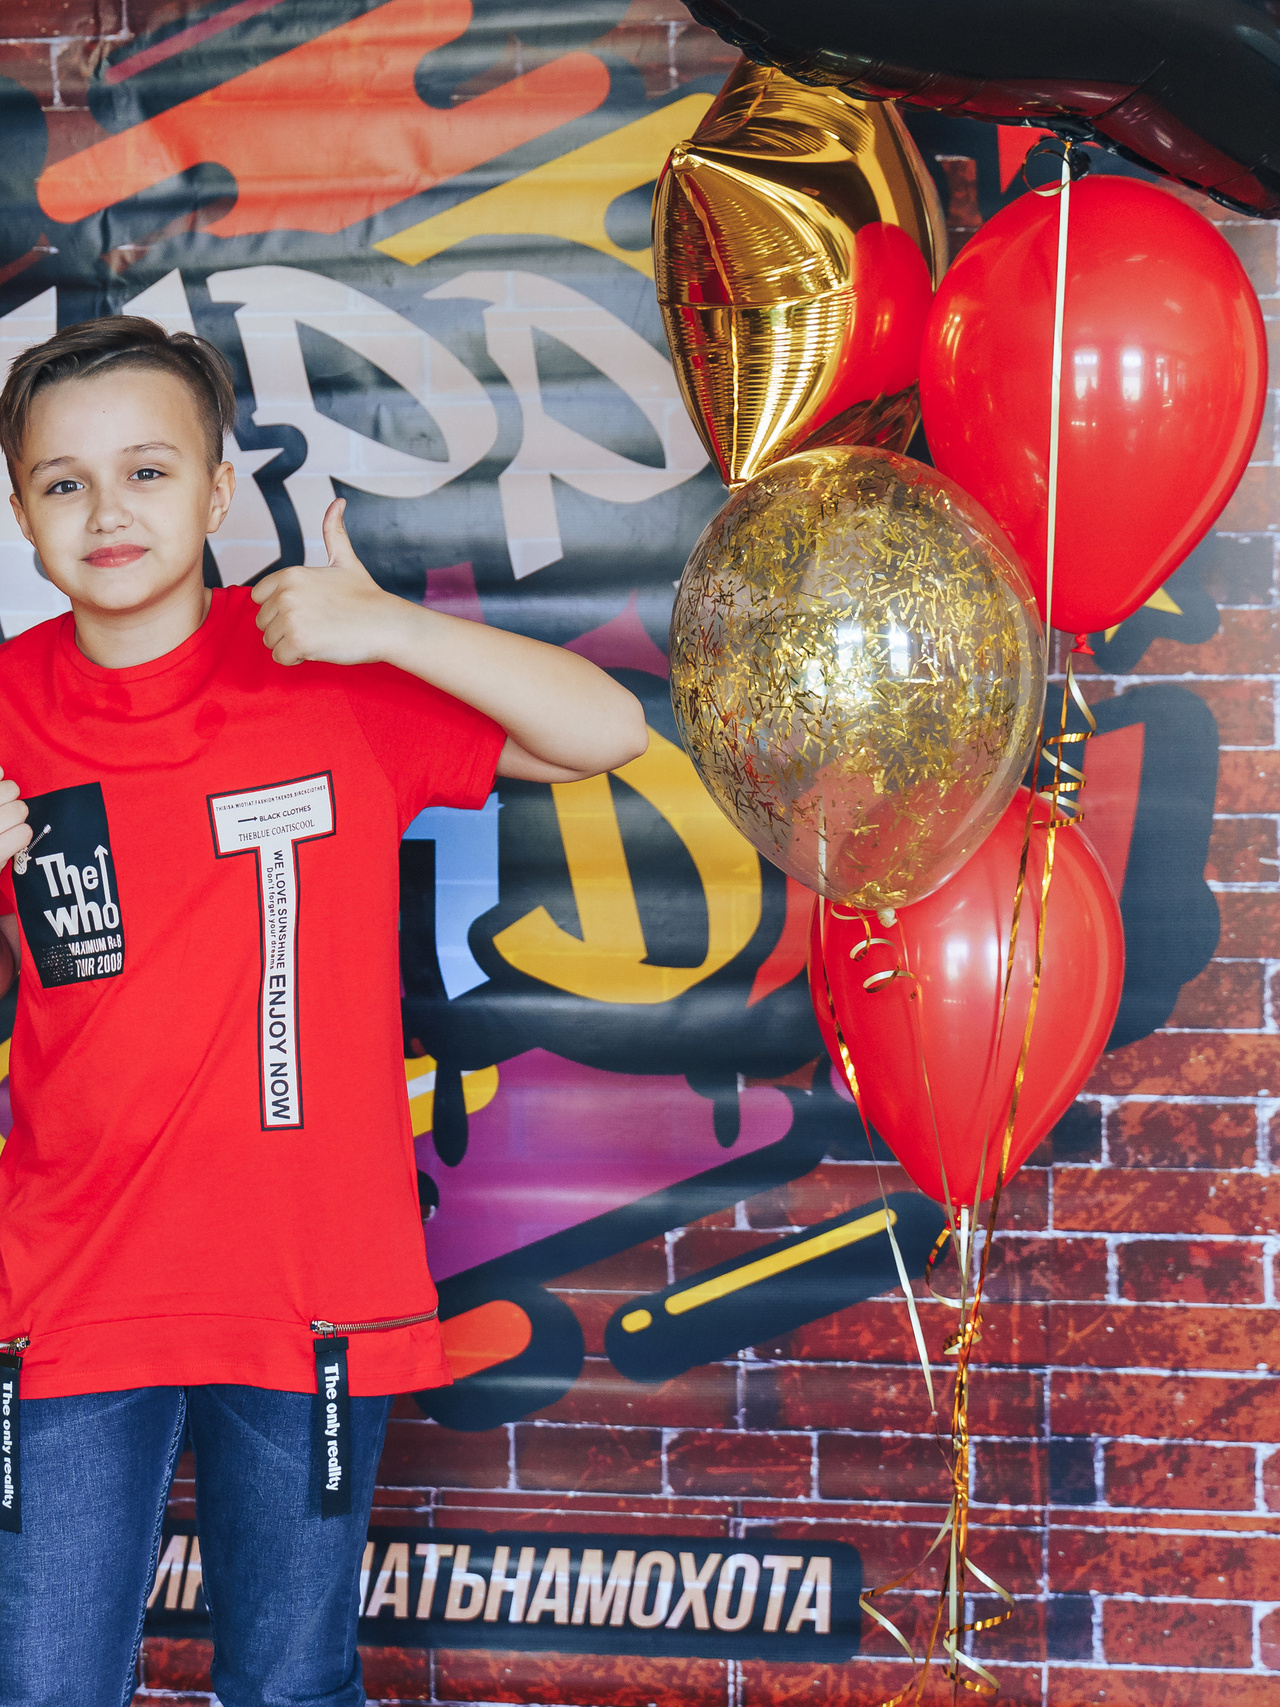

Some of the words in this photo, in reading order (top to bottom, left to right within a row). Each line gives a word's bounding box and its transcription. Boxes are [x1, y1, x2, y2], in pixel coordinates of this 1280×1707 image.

[259, 812, 281, 823] BLACK
[282, 804, 312, 818] CLOTHES
[35, 852, 99, 898] The
[273, 849, 284, 869] WE
[266, 867, 275, 890] Don't
[275, 872, 287, 905] LOVE
[267, 891, 276, 917] forget
[268, 918, 277, 938] your
[276, 908, 287, 969] SUNSHINE
[97, 951, 123, 975] 2008
[268, 974, 287, 1055] ENJOY
[269, 1062, 291, 1120] NOW
[2, 1380, 13, 1416] The
[324, 1363, 340, 1400] The
[2, 1419, 12, 1455] only
[324, 1402, 341, 1437] only
[1, 1457, 15, 1509] reality
[326, 1441, 342, 1491] reality
